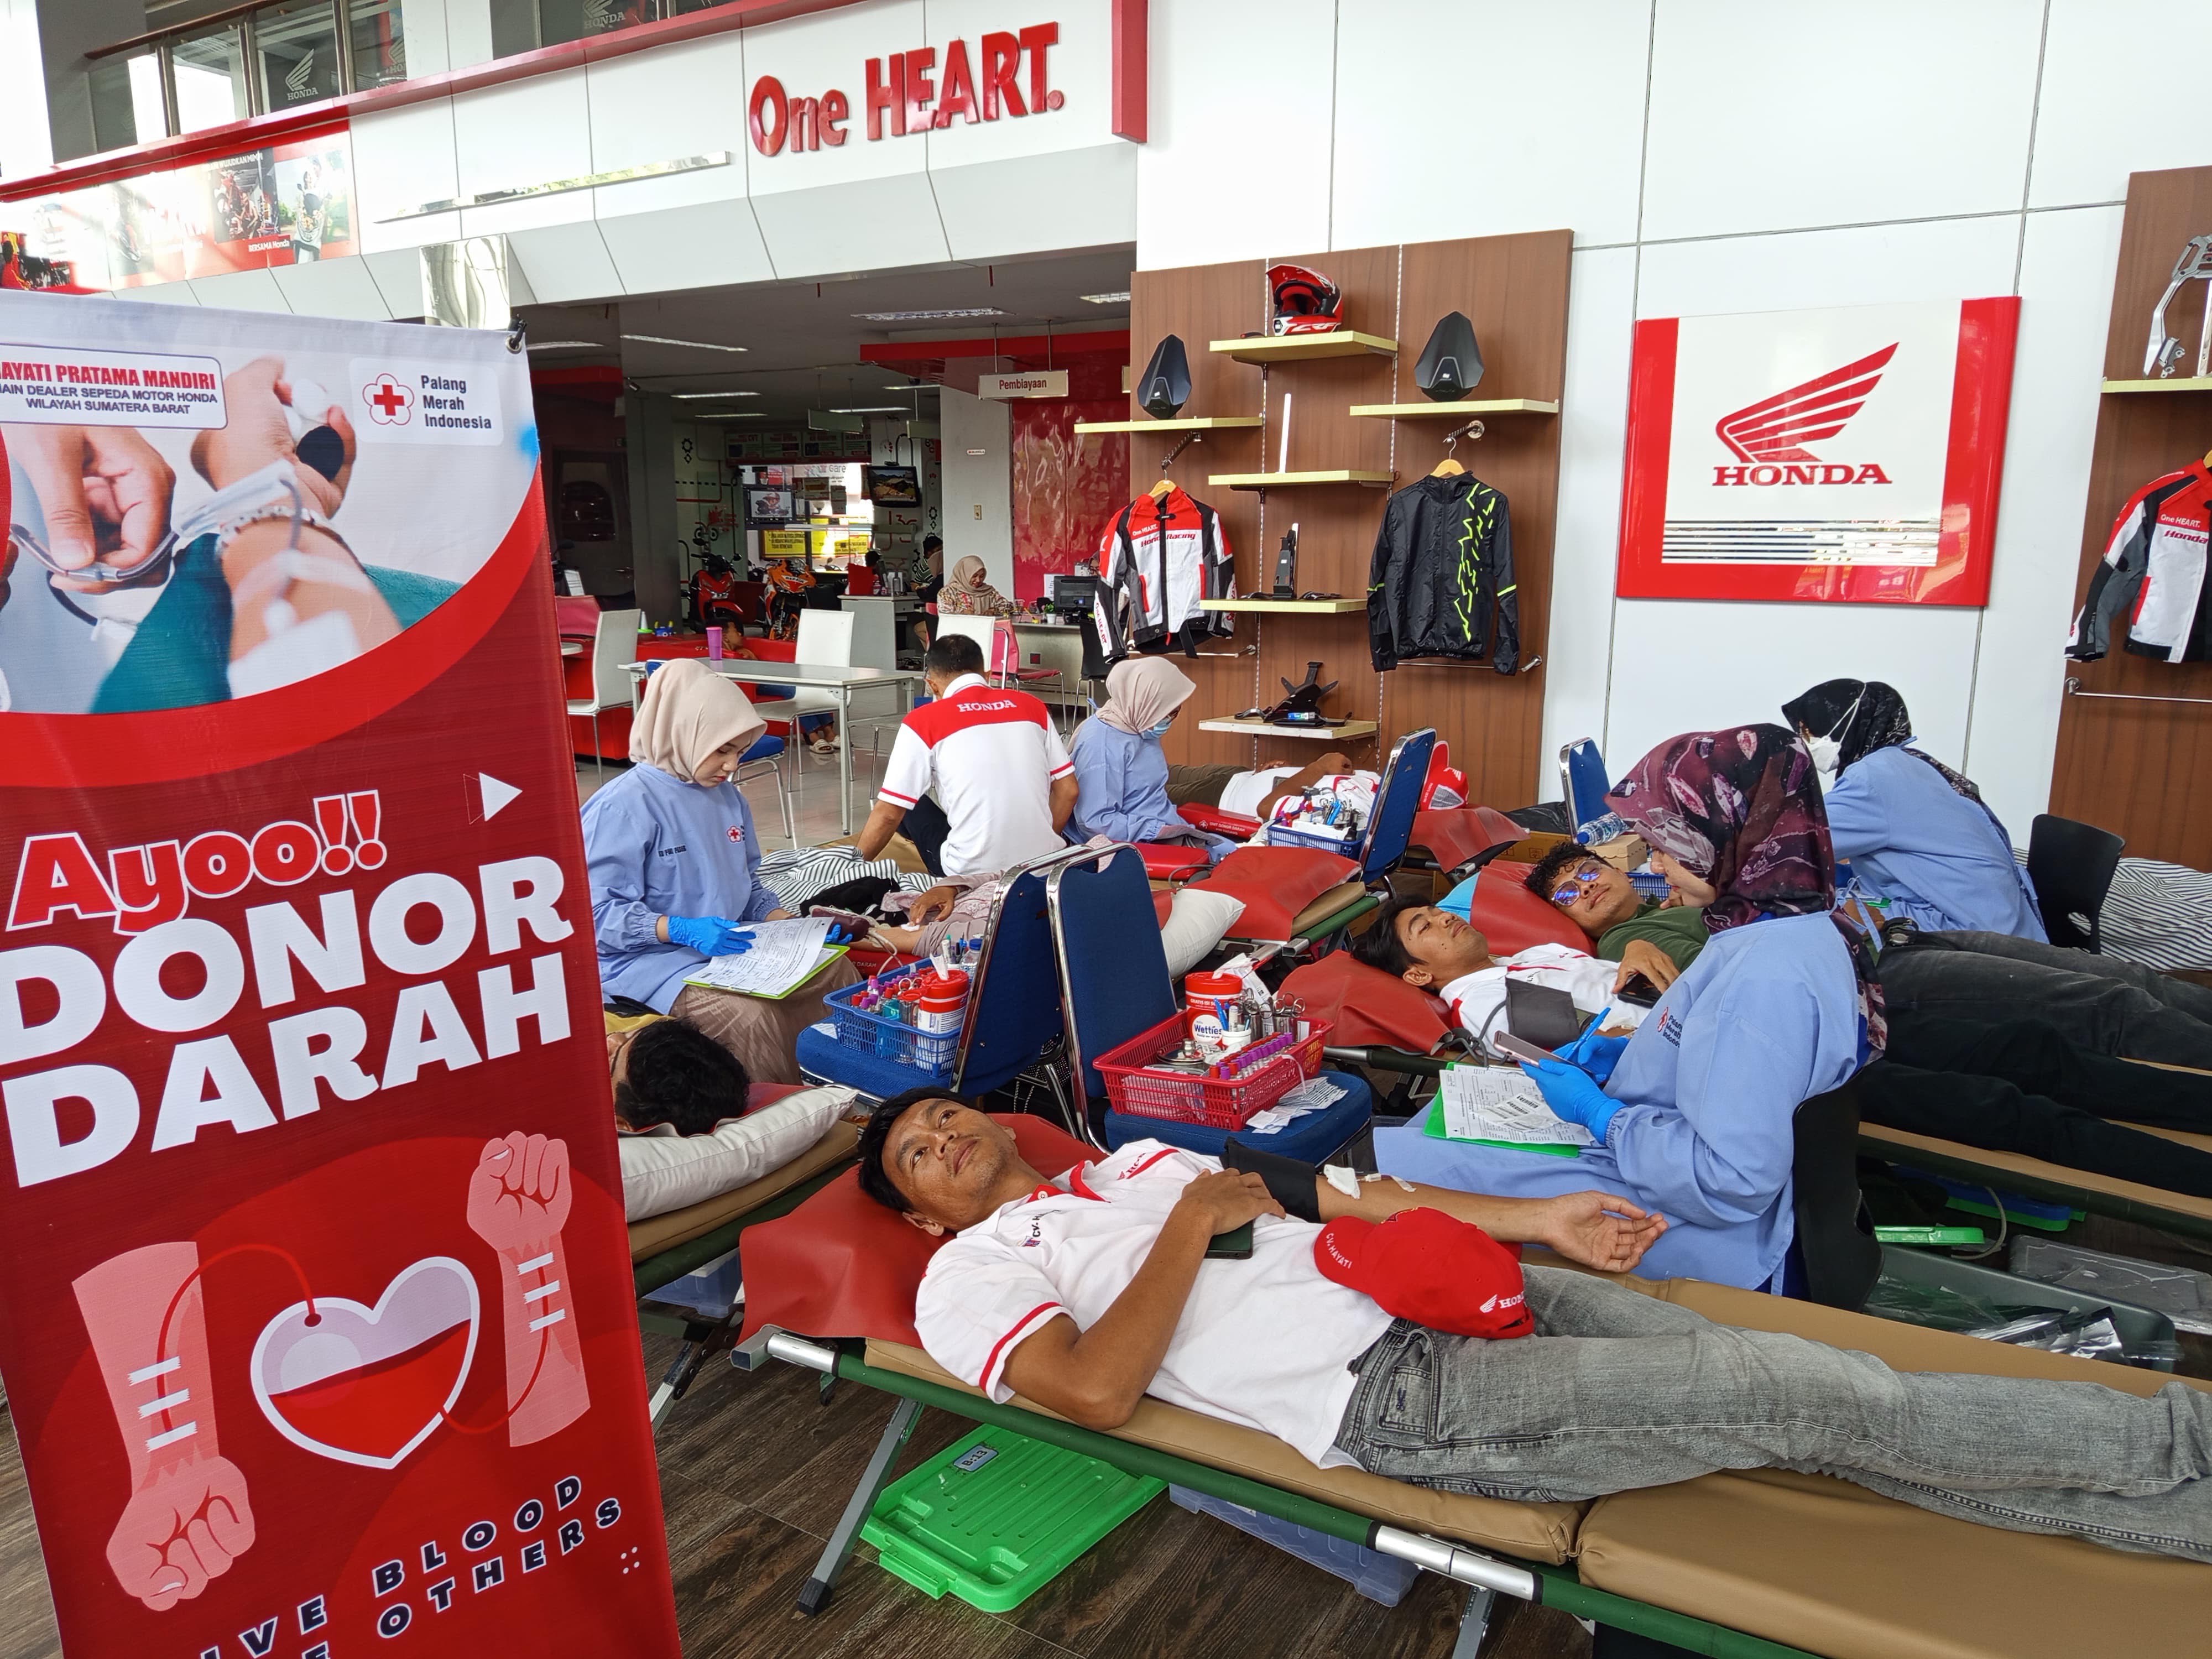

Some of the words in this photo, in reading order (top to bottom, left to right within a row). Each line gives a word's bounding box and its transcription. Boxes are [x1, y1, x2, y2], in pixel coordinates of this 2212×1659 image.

[584, 12, 626, 29] HONDA
[287, 87, 319, 101] HONDA
[749, 75, 849, 156] One
[865, 22, 1065, 142] HEART.
[248, 242, 272, 252] BERSAMA
[272, 239, 290, 248] Honda
[0, 361, 52, 382] AYATI
[56, 364, 140, 387] PRATAMA
[143, 370, 216, 390] MANDIRI
[0, 383, 23, 394] AIN
[27, 385, 77, 397] DEALER
[81, 389, 130, 400] SEPEDA
[133, 392, 174, 401] MOTOR
[178, 393, 217, 403] HONDA
[421, 375, 467, 394] Palang
[999, 379, 1047, 391] Pembiayaan
[26, 398, 81, 410] WILAYAH
[85, 401, 150, 413] SUMATERA
[153, 404, 190, 414] BARAT
[423, 395, 465, 410] Merah
[425, 414, 492, 429] Indonesia
[1712, 464, 1892, 486] HONDA
[2161, 514, 2175, 523] One
[2175, 517, 2201, 528] HEART.
[2164, 530, 2209, 544] Honda
[956, 699, 1018, 713] HONDA
[6, 789, 387, 936] Ayoo!!
[0, 855, 575, 1065] DONOR
[2, 951, 571, 1188] DARAH
[962, 1450, 988, 1466] B:13
[372, 1475, 582, 1598] BLOOD
[377, 1498, 621, 1639] OTHERS
